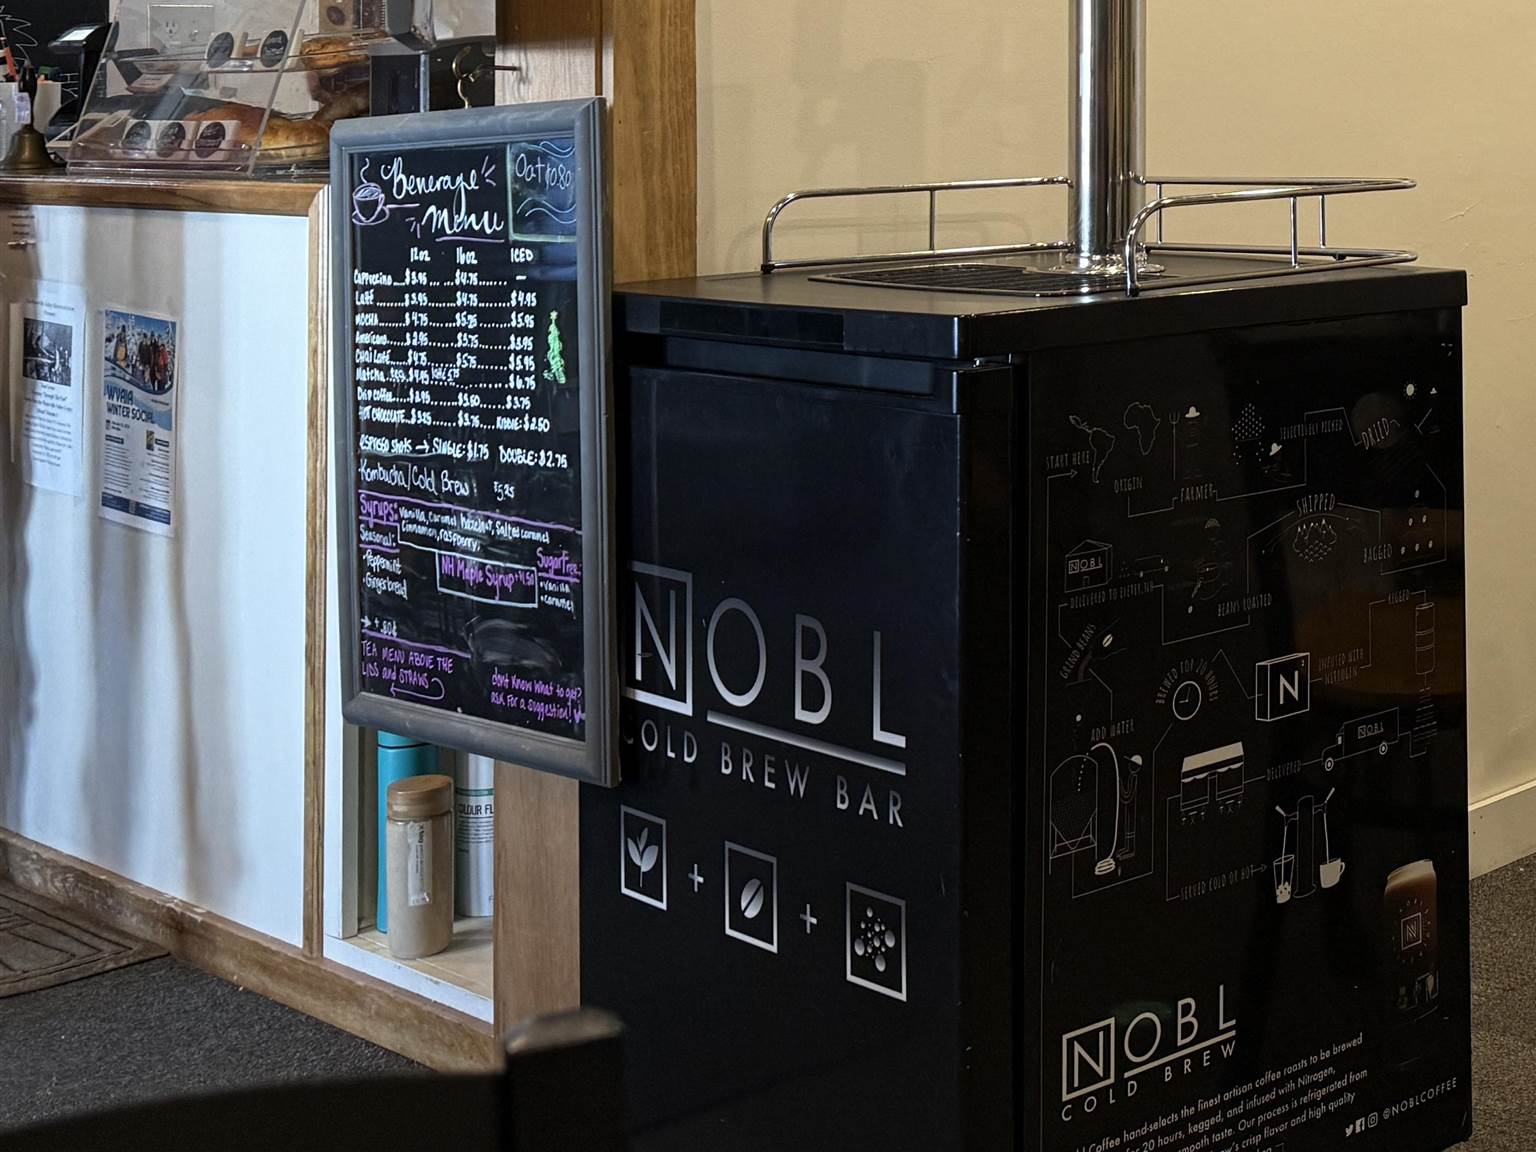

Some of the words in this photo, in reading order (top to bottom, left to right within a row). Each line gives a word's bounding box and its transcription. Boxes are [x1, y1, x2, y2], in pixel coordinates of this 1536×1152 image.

[381, 157, 480, 221] Beverage
[515, 153, 545, 183] Oat
[421, 204, 504, 235] Menu
[510, 289, 537, 306] $4.95
[361, 640, 378, 656] TEA
[382, 647, 405, 664] MENU
[408, 651, 434, 669] ABOVE
[437, 656, 454, 674] THE
[362, 662, 379, 677] LIDS
[634, 581, 906, 748] NOBL
[1279, 670, 1299, 705] N
[625, 718, 698, 764] OLD
[721, 741, 810, 798] BREW
[836, 775, 903, 828] BAR
[1073, 984, 1237, 1088] NOBL
[1062, 1080, 1138, 1122] COLD
[1164, 1040, 1236, 1082] BREW
[1181, 1107, 1195, 1120] the
[1197, 1093, 1221, 1112] finest
[1223, 1083, 1253, 1101] artisan
[1254, 1070, 1282, 1088] coffee
[1284, 1058, 1308, 1077] roasts
[1310, 1055, 1318, 1065] to
[1320, 1049, 1331, 1060] be
[1333, 1032, 1363, 1055] brewed
[1238, 1119, 1255, 1132] Our
[1257, 1103, 1290, 1127] process
[1291, 1097, 1298, 1109] is
[1299, 1073, 1347, 1105] refrigerated
[1349, 1069, 1368, 1087] from
[1141, 1138, 1155, 1152] 20
[1157, 1129, 1185, 1148] hours,
[1188, 1110, 1224, 1135] kegged,
[1227, 1100, 1244, 1118] and
[1246, 1087, 1276, 1111] infused
[1278, 1079, 1296, 1097] with
[1298, 1065, 1336, 1088] Nitrogen,
[1241, 1133, 1262, 1149] crisp
[1264, 1121, 1289, 1140] flavor
[1290, 1110, 1307, 1127] and
[1308, 1102, 1327, 1120] high
